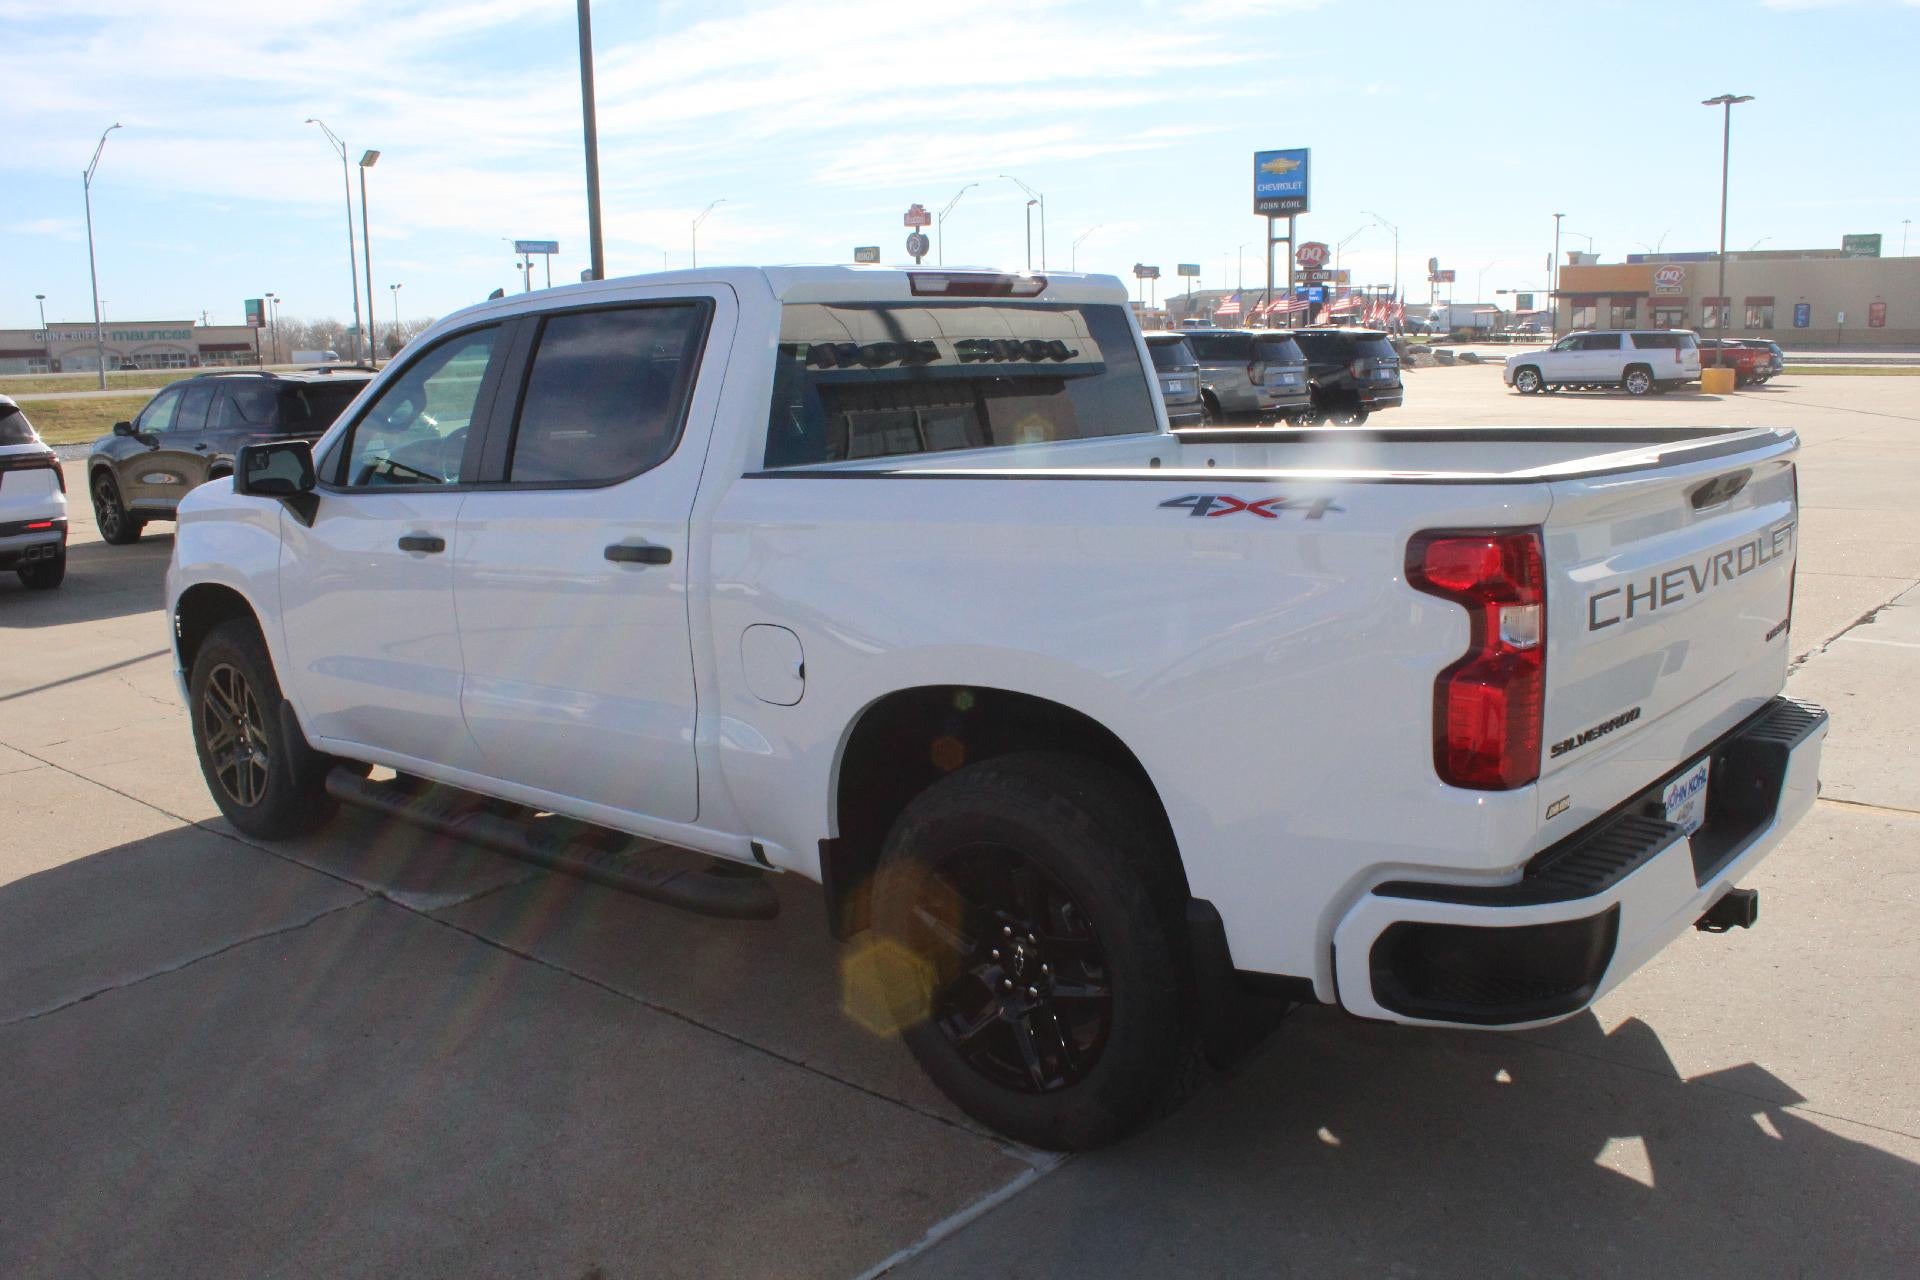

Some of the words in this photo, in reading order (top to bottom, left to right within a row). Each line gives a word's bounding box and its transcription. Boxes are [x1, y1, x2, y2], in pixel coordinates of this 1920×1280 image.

[1257, 181, 1303, 192] CHEVROLET
[1259, 201, 1279, 210] JOHN
[1281, 200, 1301, 209] KOHL
[1300, 248, 1322, 261] DQ
[1589, 521, 1796, 632] CHEVROLET
[1550, 706, 1641, 759] SILVERADO
